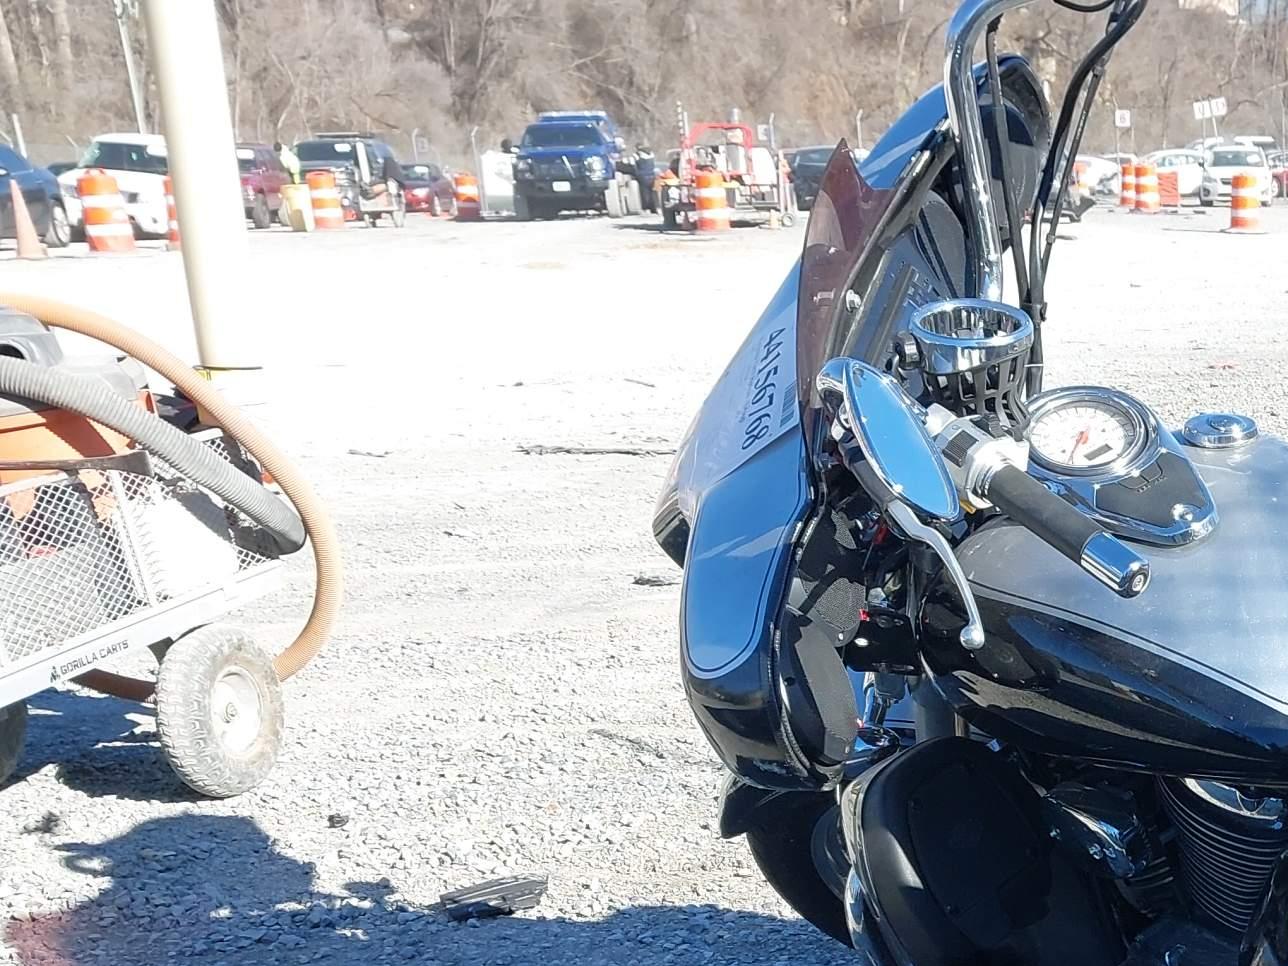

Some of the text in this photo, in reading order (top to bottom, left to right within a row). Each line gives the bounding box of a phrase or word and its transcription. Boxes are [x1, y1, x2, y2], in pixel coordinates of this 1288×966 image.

[741, 327, 787, 450] 44156768
[60, 640, 129, 675] GORILLA CARTS
